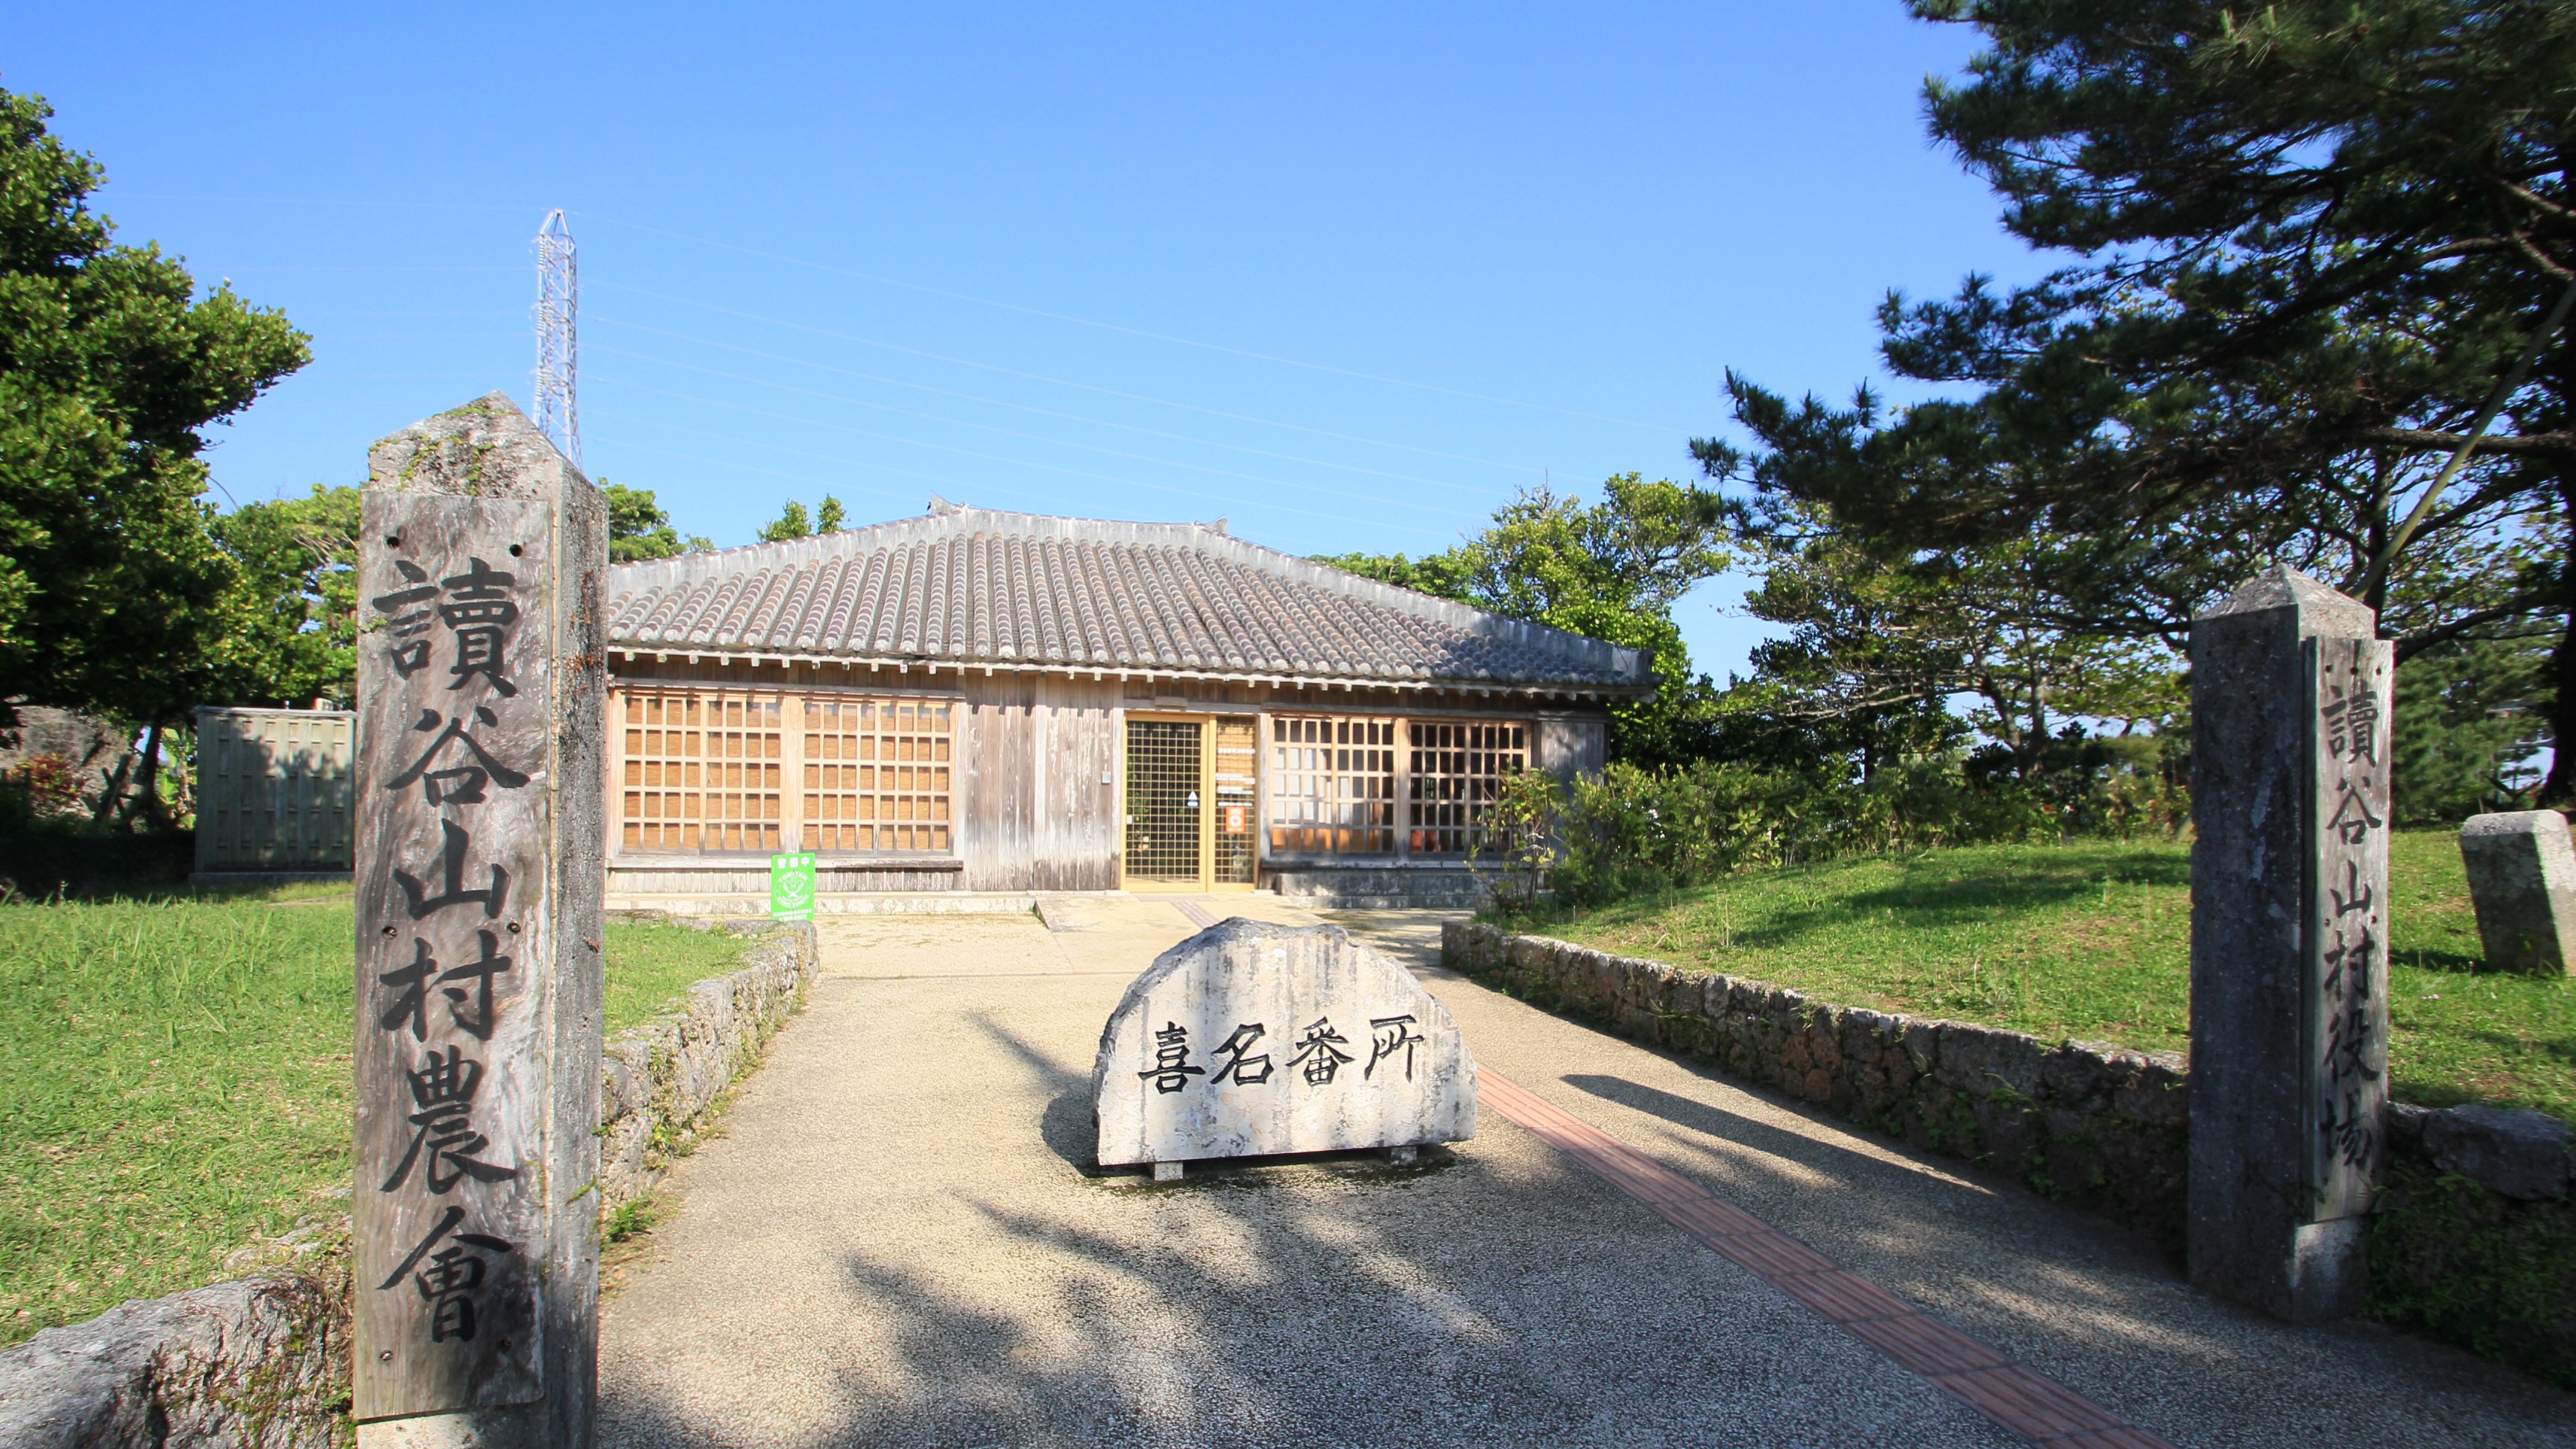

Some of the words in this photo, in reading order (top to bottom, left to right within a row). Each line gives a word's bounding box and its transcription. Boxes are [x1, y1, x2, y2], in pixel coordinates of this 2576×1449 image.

[372, 556, 531, 1344] 讀谷山村農會
[1138, 1015, 1424, 1095] 喜名番所
[2320, 681, 2381, 1167] 讀谷山村役場
